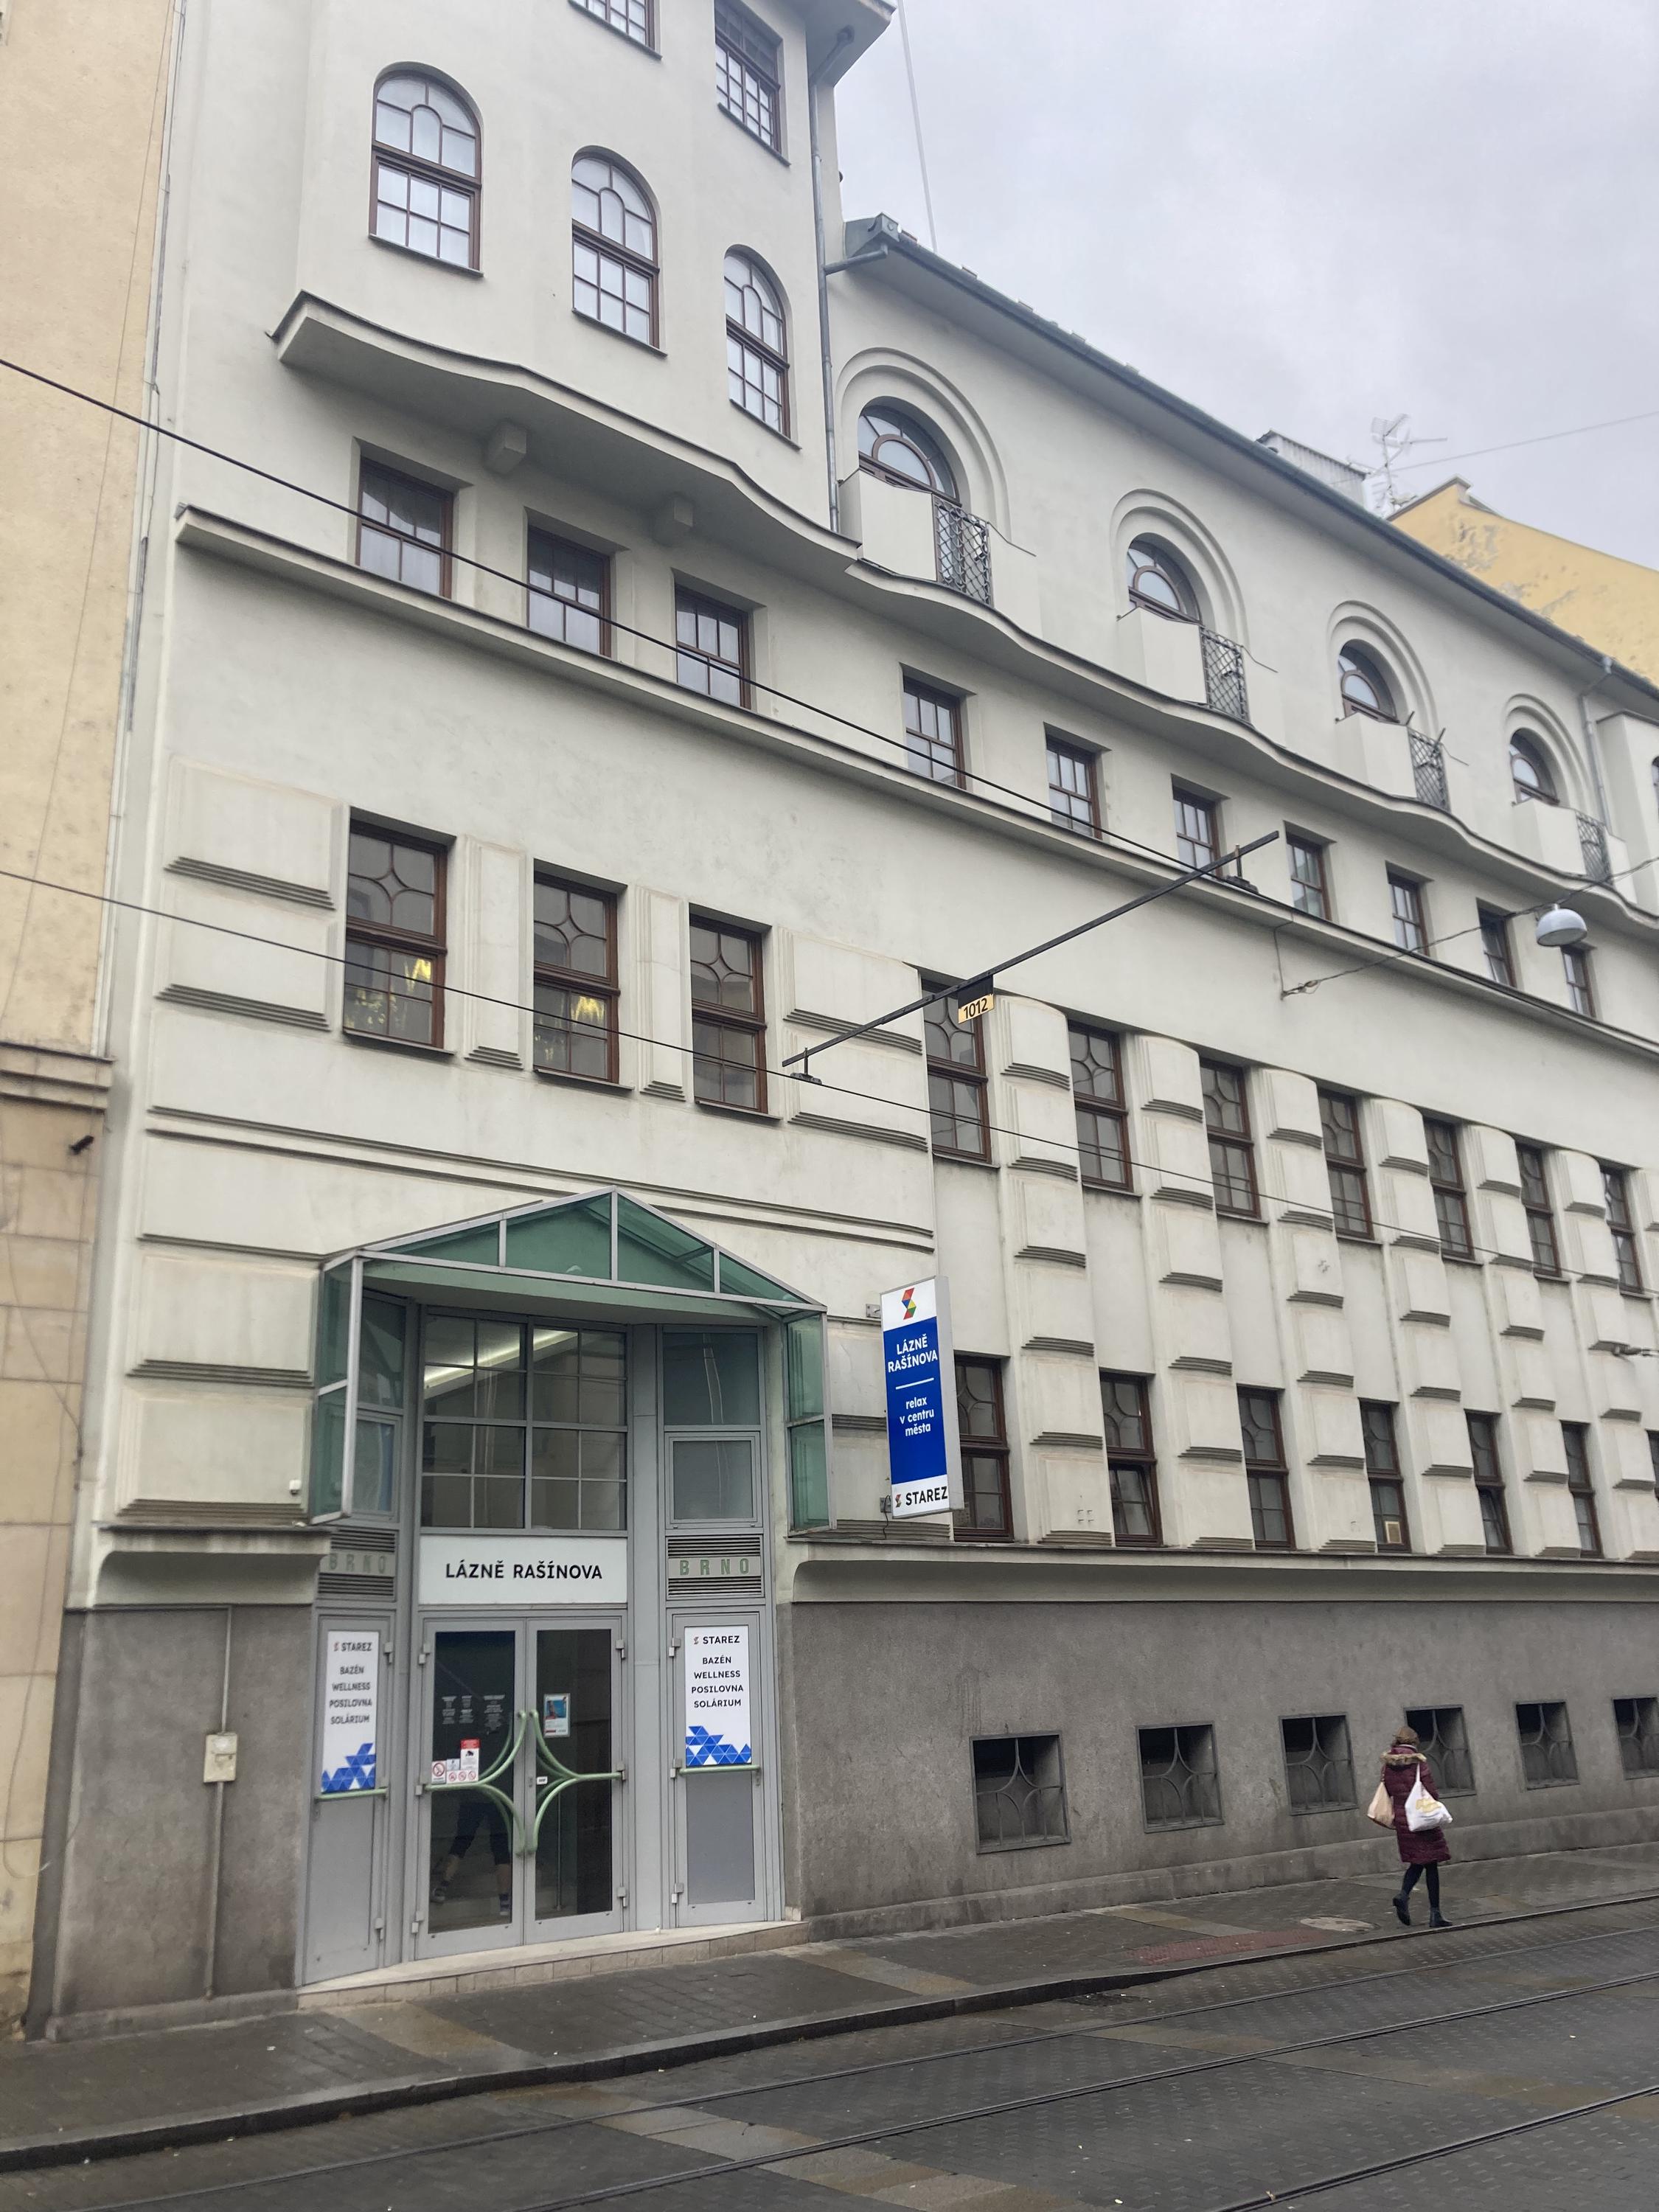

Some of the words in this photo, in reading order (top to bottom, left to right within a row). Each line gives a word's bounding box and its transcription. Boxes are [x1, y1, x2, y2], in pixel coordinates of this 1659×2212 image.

[963, 998, 989, 1020] 1012
[896, 1333, 928, 1355] LÁZNĚ
[887, 1349, 938, 1373] RAŠÍNOVA
[905, 1396, 928, 1409] relax
[900, 1415, 906, 1425] v
[907, 1407, 935, 1422] centru
[905, 1422, 931, 1437] města
[905, 1485, 948, 1506] STAREZ
[445, 1559, 504, 1579] LÁZNĚ
[513, 1559, 603, 1579] RAŠÍNOVA
[680, 1558, 749, 1576] BRNO
[703, 1635, 740, 1644] STAREZ
[341, 1642, 372, 1652] STAREZ
[703, 1655, 731, 1665] BAZÉN
[340, 1665, 364, 1674] BAZÉN
[694, 1670, 741, 1680] WELLNESS
[332, 1682, 370, 1691] WELLNESS
[692, 1684, 744, 1694] POSILOVNA
[329, 1698, 372, 1708] POSILOVNA
[694, 1698, 742, 1708] SOLÁRIUM
[330, 1713, 369, 1724] SOLÁRIUM
